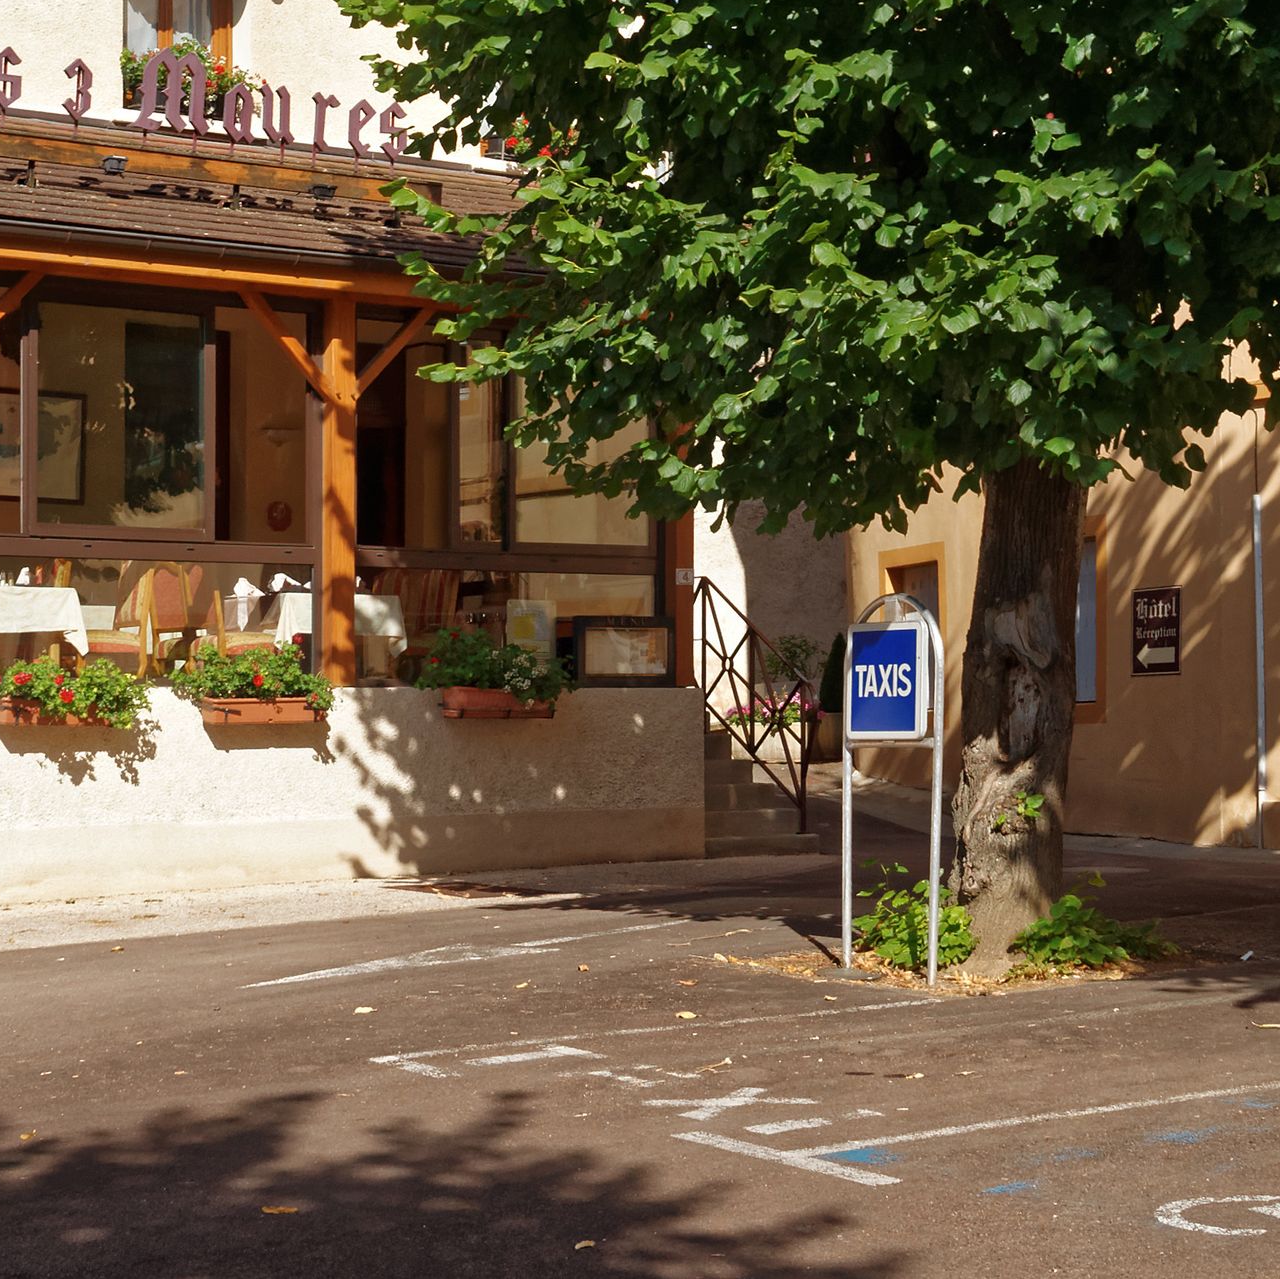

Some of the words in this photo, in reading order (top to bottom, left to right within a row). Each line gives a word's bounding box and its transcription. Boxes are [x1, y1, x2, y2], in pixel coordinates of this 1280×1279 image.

[62, 58, 93, 119] 3
[127, 47, 408, 160] Maures
[1136, 596, 1177, 624] Hôtel
[1136, 626, 1177, 640] Réception
[855, 663, 912, 698] TAXIS
